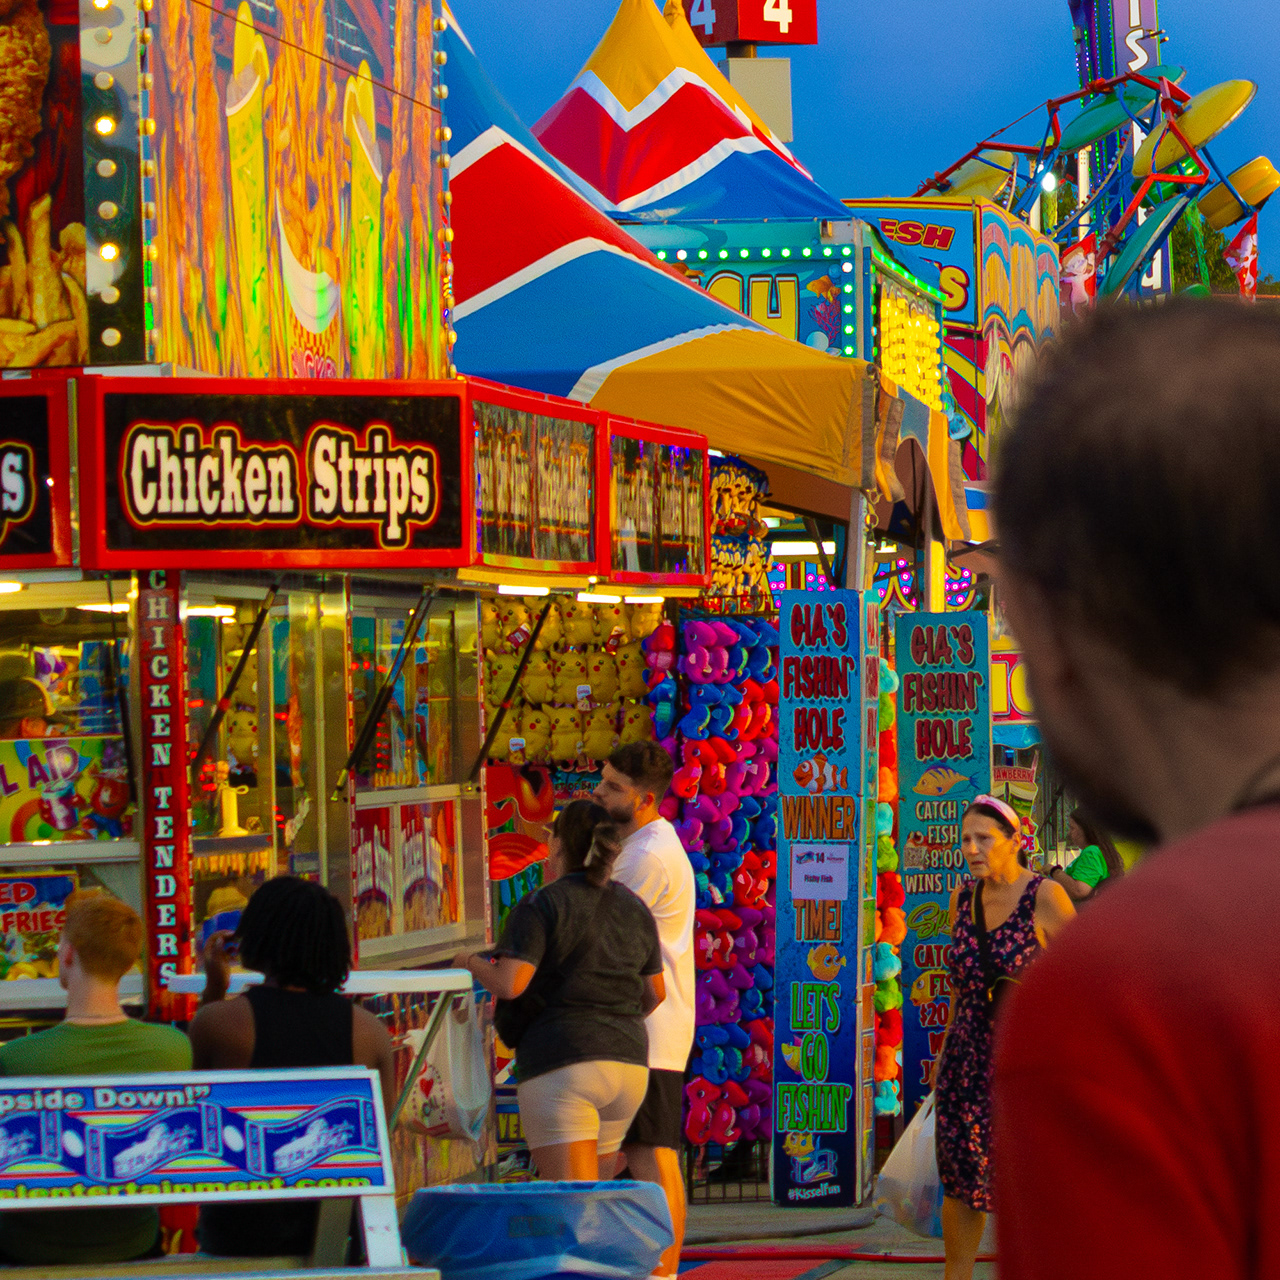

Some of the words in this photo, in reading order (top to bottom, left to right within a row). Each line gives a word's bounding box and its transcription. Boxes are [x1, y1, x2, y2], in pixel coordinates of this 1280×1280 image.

[131, 434, 294, 516] Chicken
[314, 434, 430, 540] Strips
[790, 602, 848, 647] GIA'S
[910, 623, 975, 666] GIA'S
[147, 570, 171, 766] CHICKEN
[793, 706, 846, 752] HOLE
[915, 717, 974, 761] HOLE
[781, 795, 857, 840] WINNER
[915, 800, 957, 821] CATCH
[927, 824, 959, 844] FISH
[154, 786, 178, 987] TENDERS
[905, 873, 943, 893] WINS
[792, 898, 842, 942] TIME!
[790, 981, 842, 1033] LET'S
[801, 1032, 829, 1083] GO
[787, 1183, 841, 1201] #KisselFun
